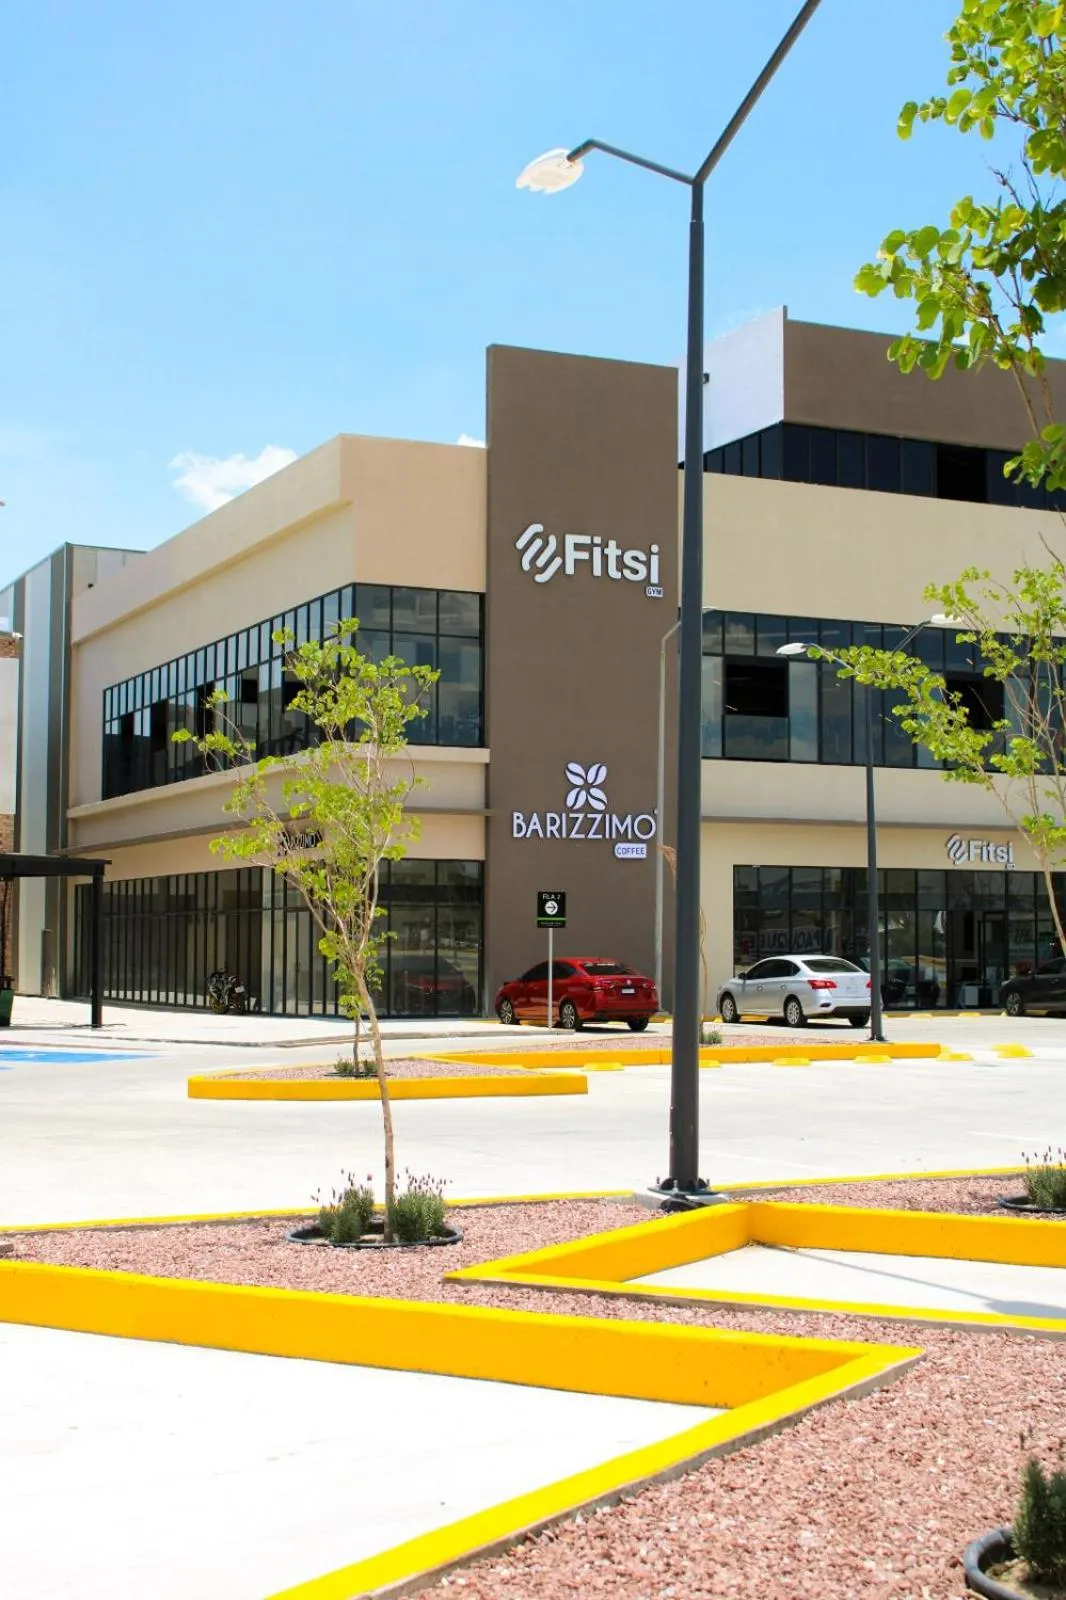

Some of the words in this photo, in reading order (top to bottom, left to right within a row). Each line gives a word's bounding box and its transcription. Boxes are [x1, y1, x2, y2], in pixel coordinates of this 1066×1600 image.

[564, 533, 660, 584] Fitsi
[647, 587, 662, 596] GYM
[512, 811, 656, 840] BARIZZIMO
[616, 847, 645, 856] COFFEE
[968, 839, 1014, 864] Fitsi
